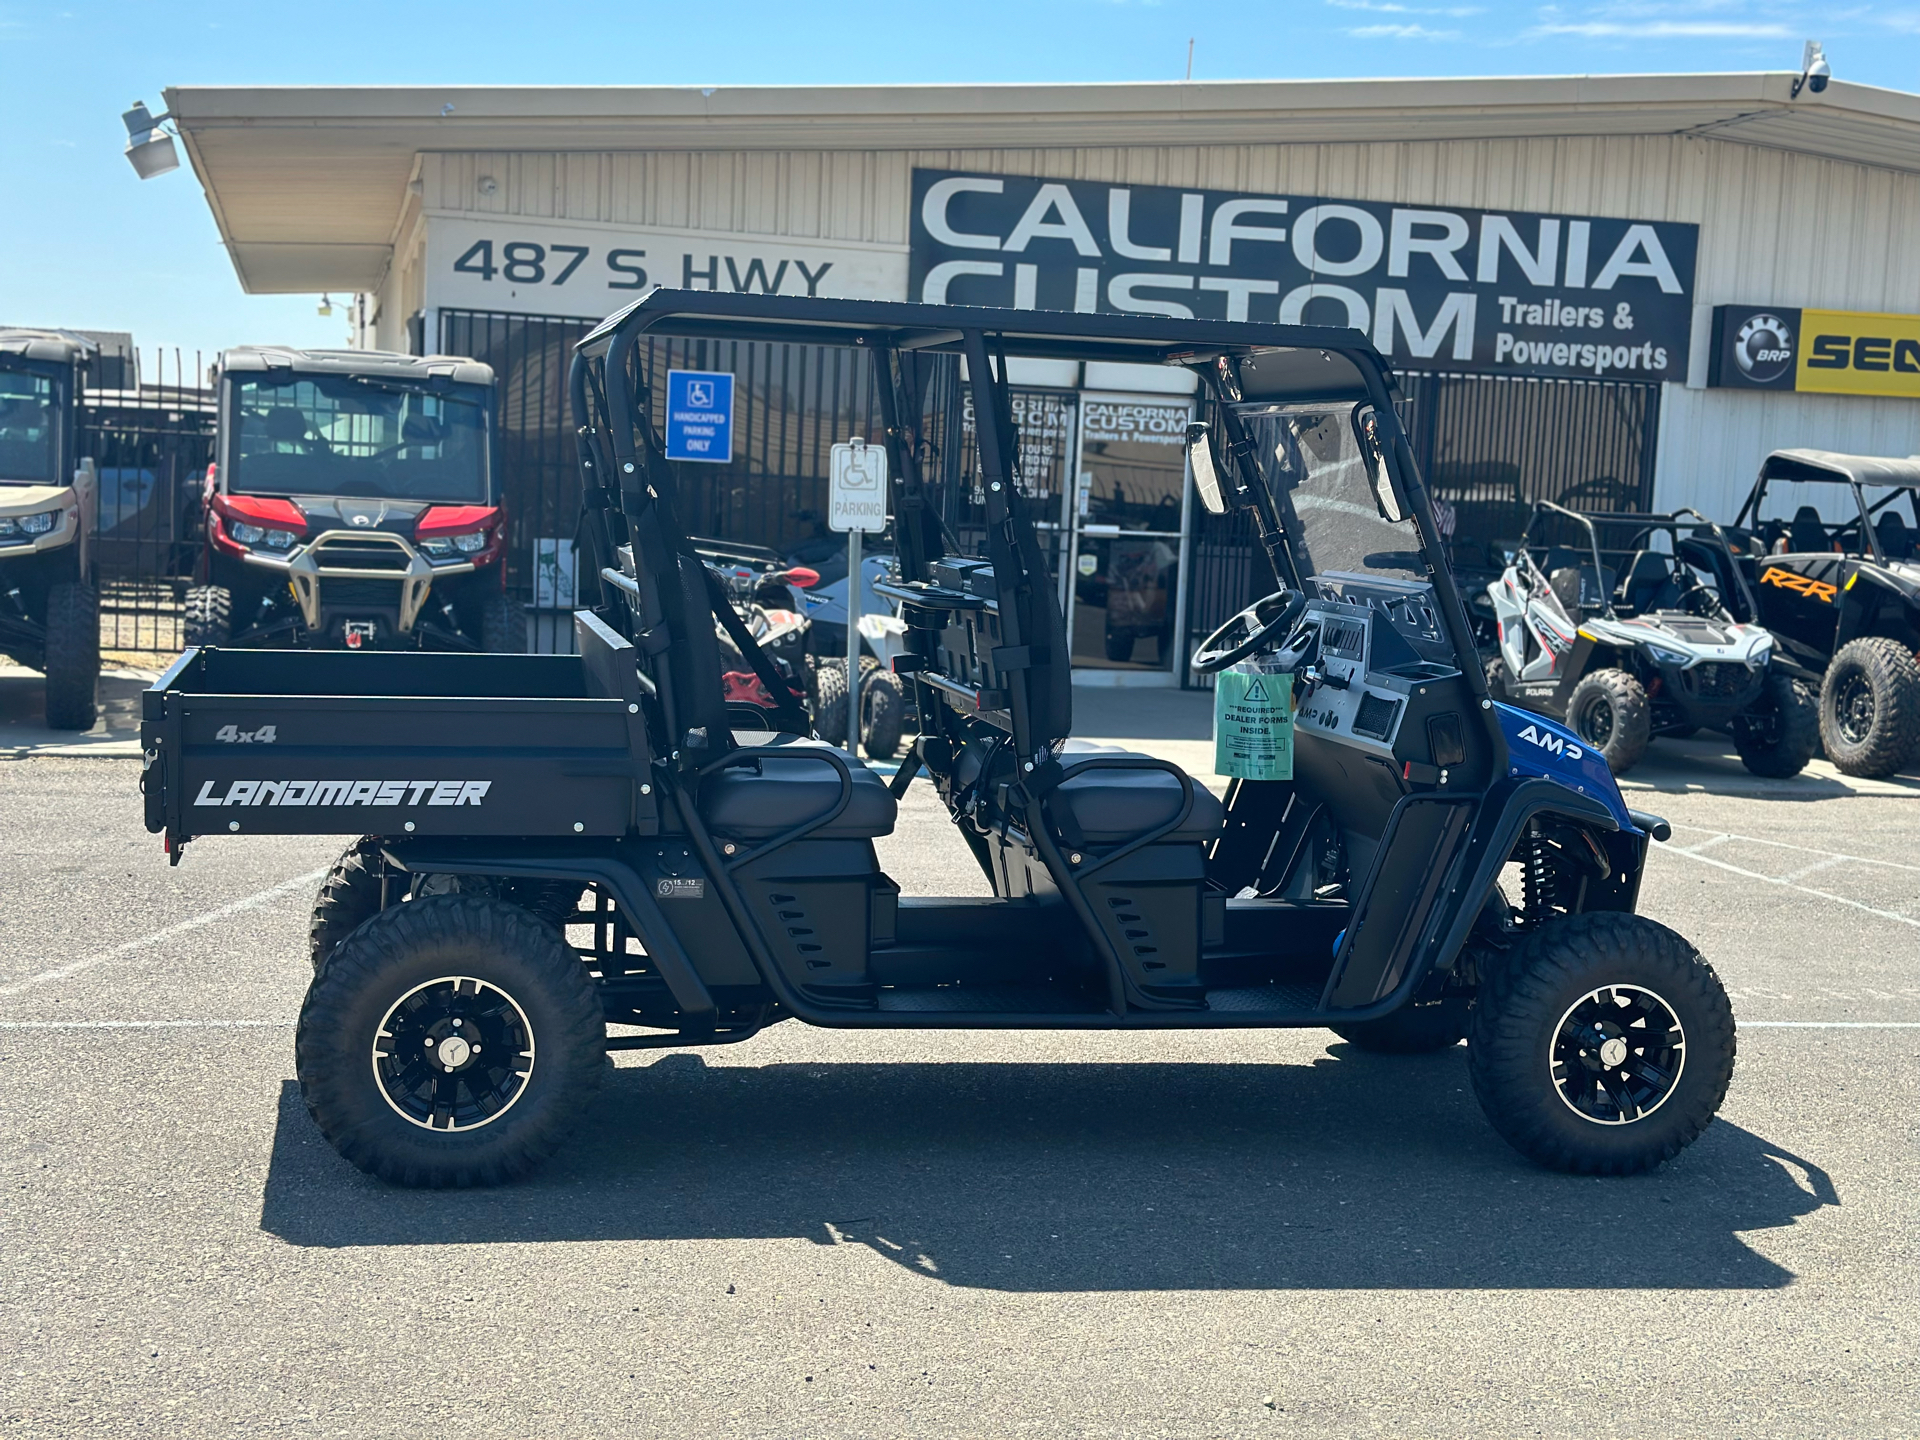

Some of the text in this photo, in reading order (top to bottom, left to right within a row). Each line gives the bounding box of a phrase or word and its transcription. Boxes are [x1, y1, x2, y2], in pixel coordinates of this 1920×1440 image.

[922, 177, 1684, 294] CALIFORNIA
[453, 239, 590, 286] 487
[682, 253, 834, 298] HWY
[922, 260, 1478, 361] CUSTOM
[1498, 296, 1635, 330] Trailers &
[1494, 332, 1668, 375] Powersports
[1756, 349, 1791, 362] BRP
[673, 411, 726, 425] HANDICAPPED
[1085, 404, 1188, 420] CALIFORNIA
[682, 425, 716, 437] PARKING
[1085, 415, 1188, 434] CUSTOM
[686, 439, 711, 452] ONLY
[1084, 429, 1187, 446] Trailers & Powersports
[834, 501, 882, 517] PARKING
[1760, 567, 1838, 603] RZR
[1525, 688, 1554, 697] POLARIS
[1224, 713, 1289, 725] DEALER FORMS
[215, 725, 277, 743] 4x4
[1517, 725, 1583, 760] AMP
[193, 780, 492, 806] LANDMASTER
